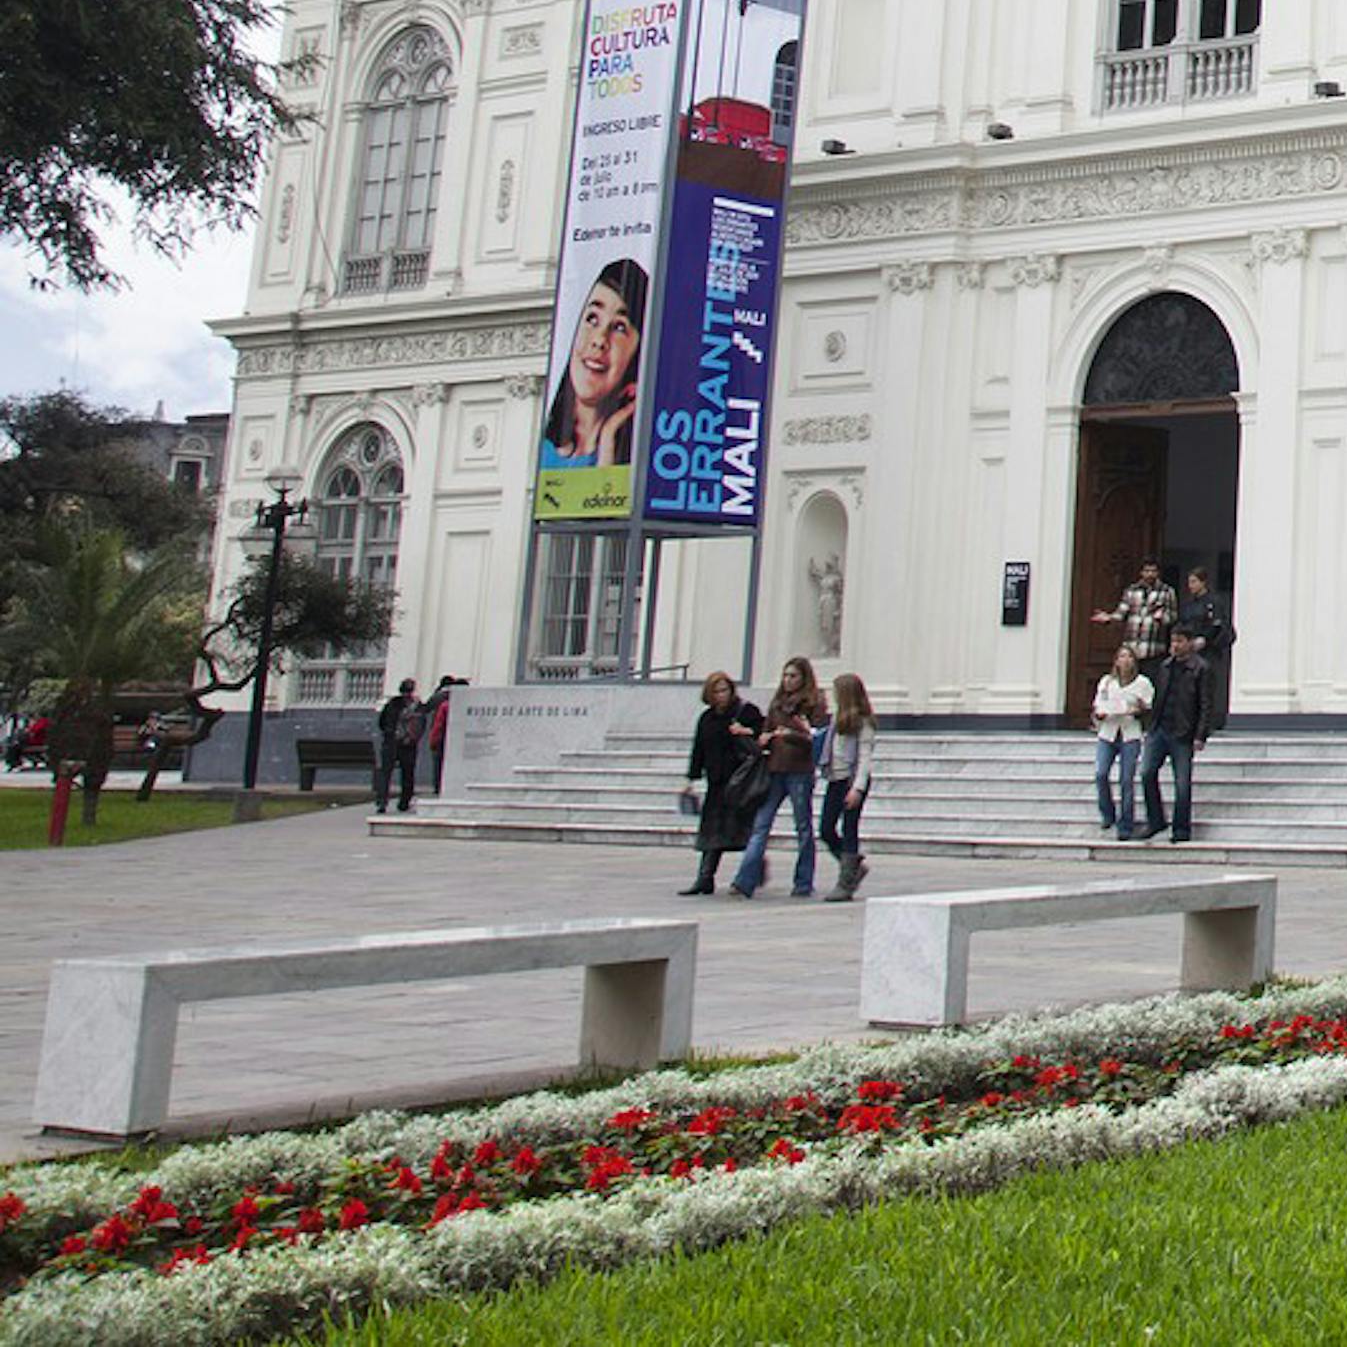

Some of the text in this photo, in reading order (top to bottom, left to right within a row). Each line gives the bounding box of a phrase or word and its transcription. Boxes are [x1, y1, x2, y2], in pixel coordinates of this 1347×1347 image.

[592, 1, 677, 37] DISFRUTA
[591, 26, 670, 57] CULTURA
[588, 54, 634, 78] PARA
[588, 73, 642, 99] TODOS
[687, 236, 742, 514] ERRANTES
[650, 410, 692, 511] LOS
[721, 397, 760, 516] MALI
[467, 706, 499, 716] MUSEO
[502, 706, 514, 716] DE
[518, 706, 543, 716] ARTE
